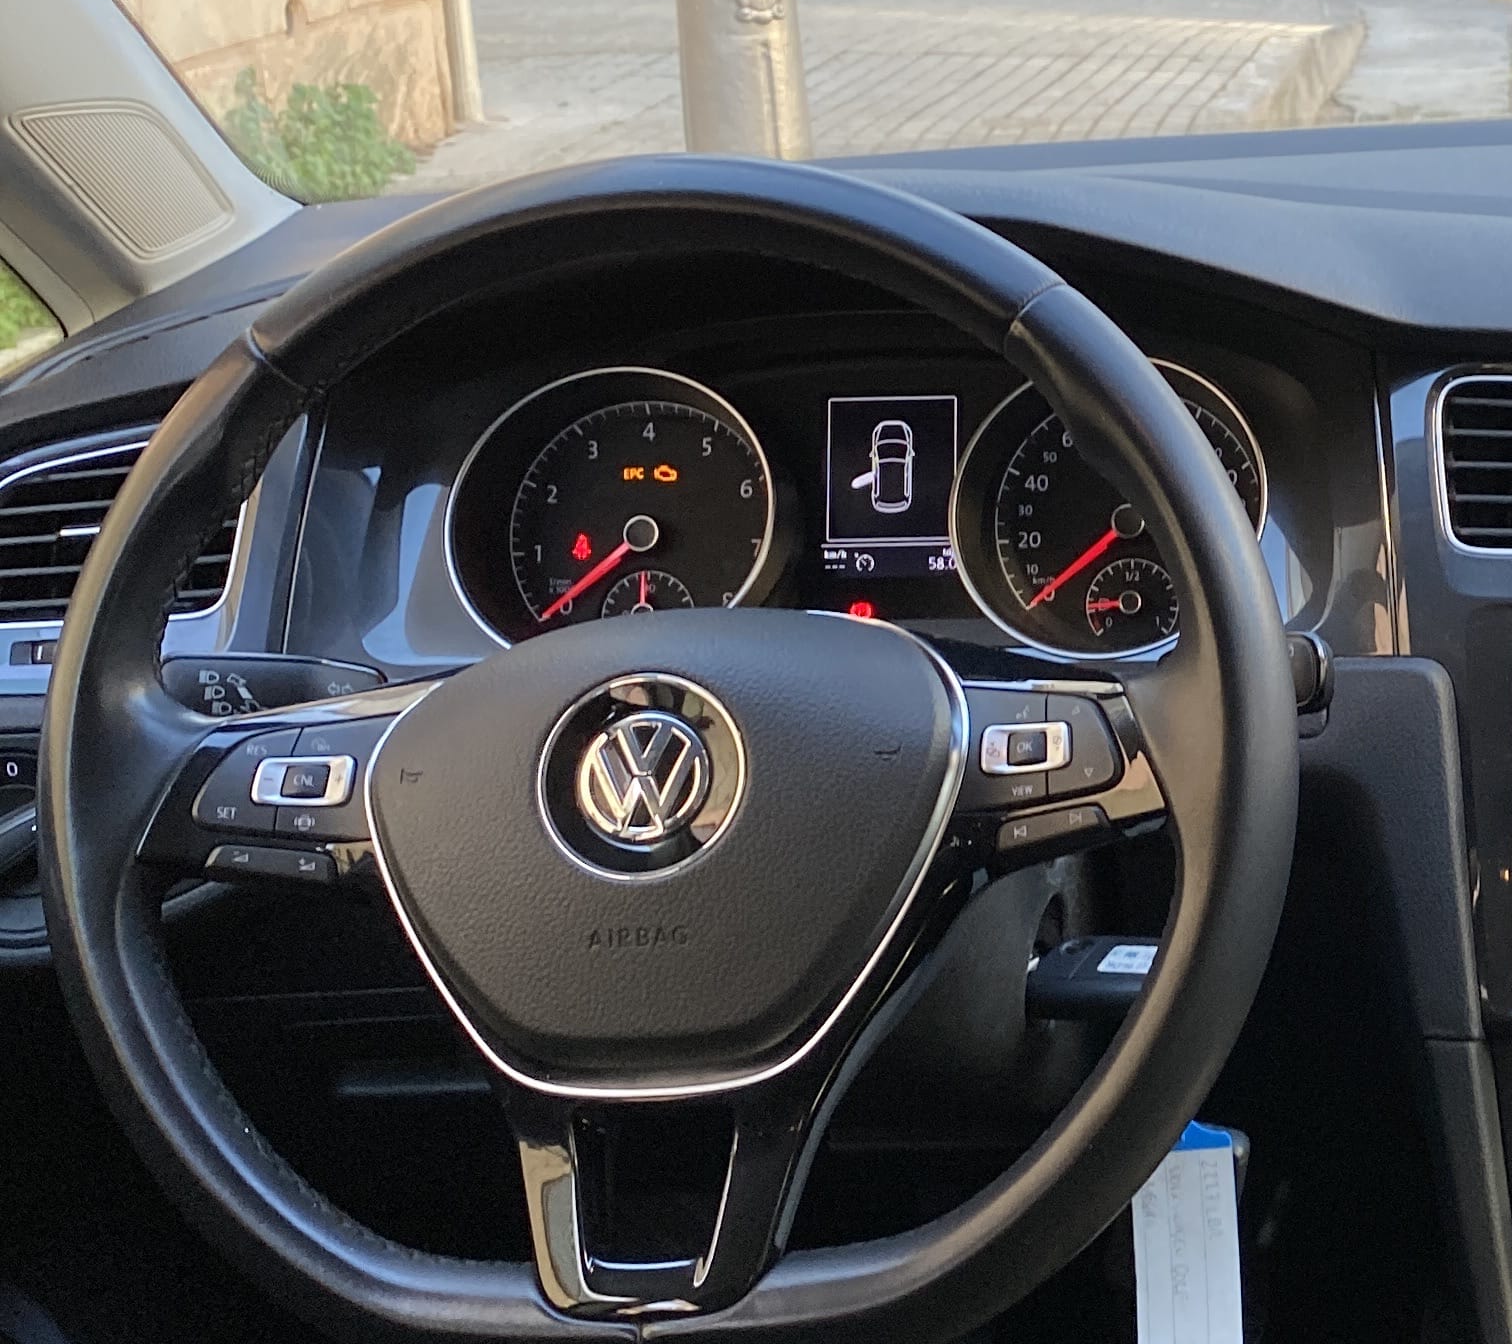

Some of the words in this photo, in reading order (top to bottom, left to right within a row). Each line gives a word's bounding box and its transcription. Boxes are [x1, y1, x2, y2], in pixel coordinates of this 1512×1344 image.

[642, 422, 656, 441] 4
[588, 440, 599, 459] 3
[701, 437, 713, 457] 5
[1043, 452, 1058, 464] 50
[622, 466, 646, 481] EPC
[740, 480, 754, 499] 6
[1024, 474, 1049, 492] 40
[547, 485, 558, 504] 2
[1018, 504, 1033, 516] 30
[1018, 531, 1042, 549] 20
[534, 544, 542, 564] 1
[823, 549, 848, 560] km/h
[1026, 563, 1039, 576] 10
[1125, 570, 1140, 582] 1/2
[246, 744, 268, 756] RES
[1016, 741, 1033, 753] OK
[293, 774, 315, 788] CNL
[1011, 784, 1034, 797] VIEW
[216, 806, 237, 820] SET
[588, 924, 689, 949] AIRBAG
